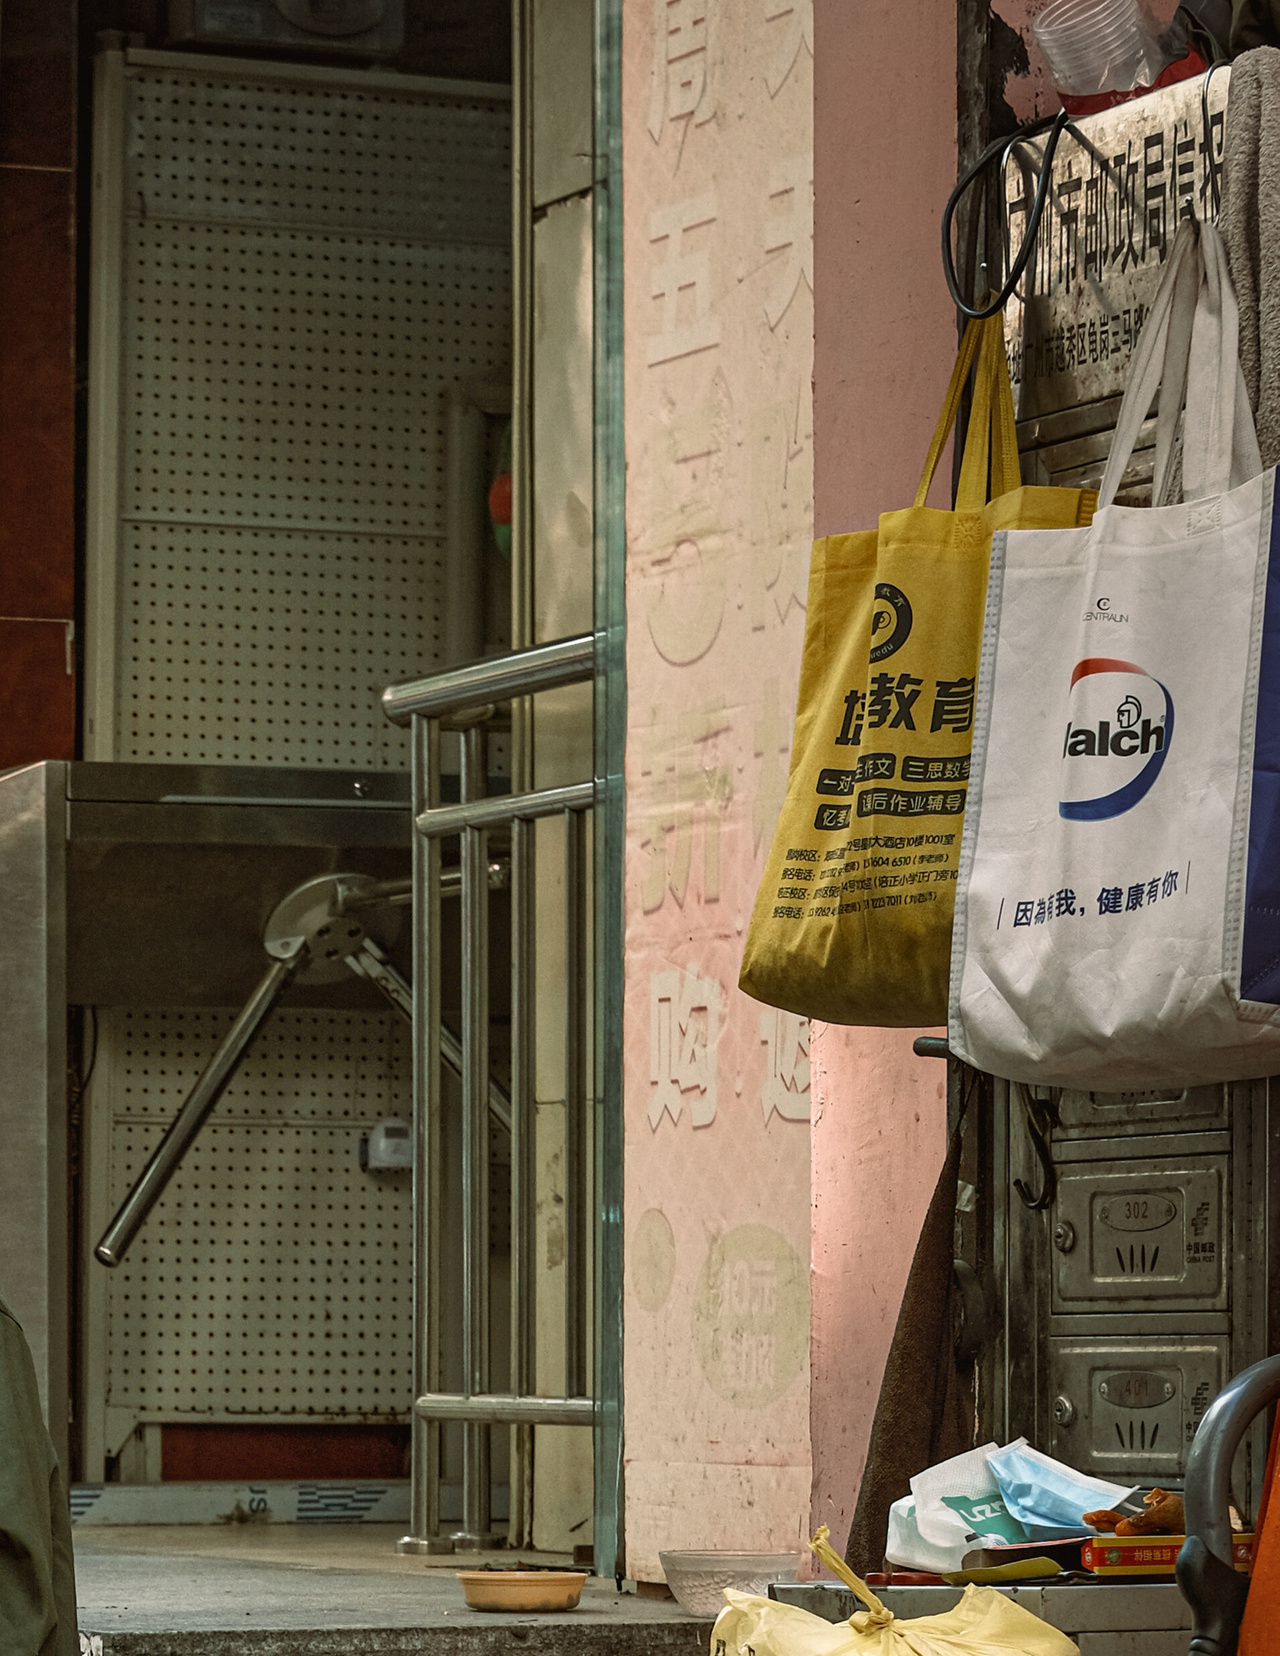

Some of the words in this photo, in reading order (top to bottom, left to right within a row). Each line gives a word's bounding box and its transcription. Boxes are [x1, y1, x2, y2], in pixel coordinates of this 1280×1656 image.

[1063, 717, 1165, 759] alch
[1125, 1201, 1148, 1220] 302
[1124, 1378, 1149, 1397] 401
